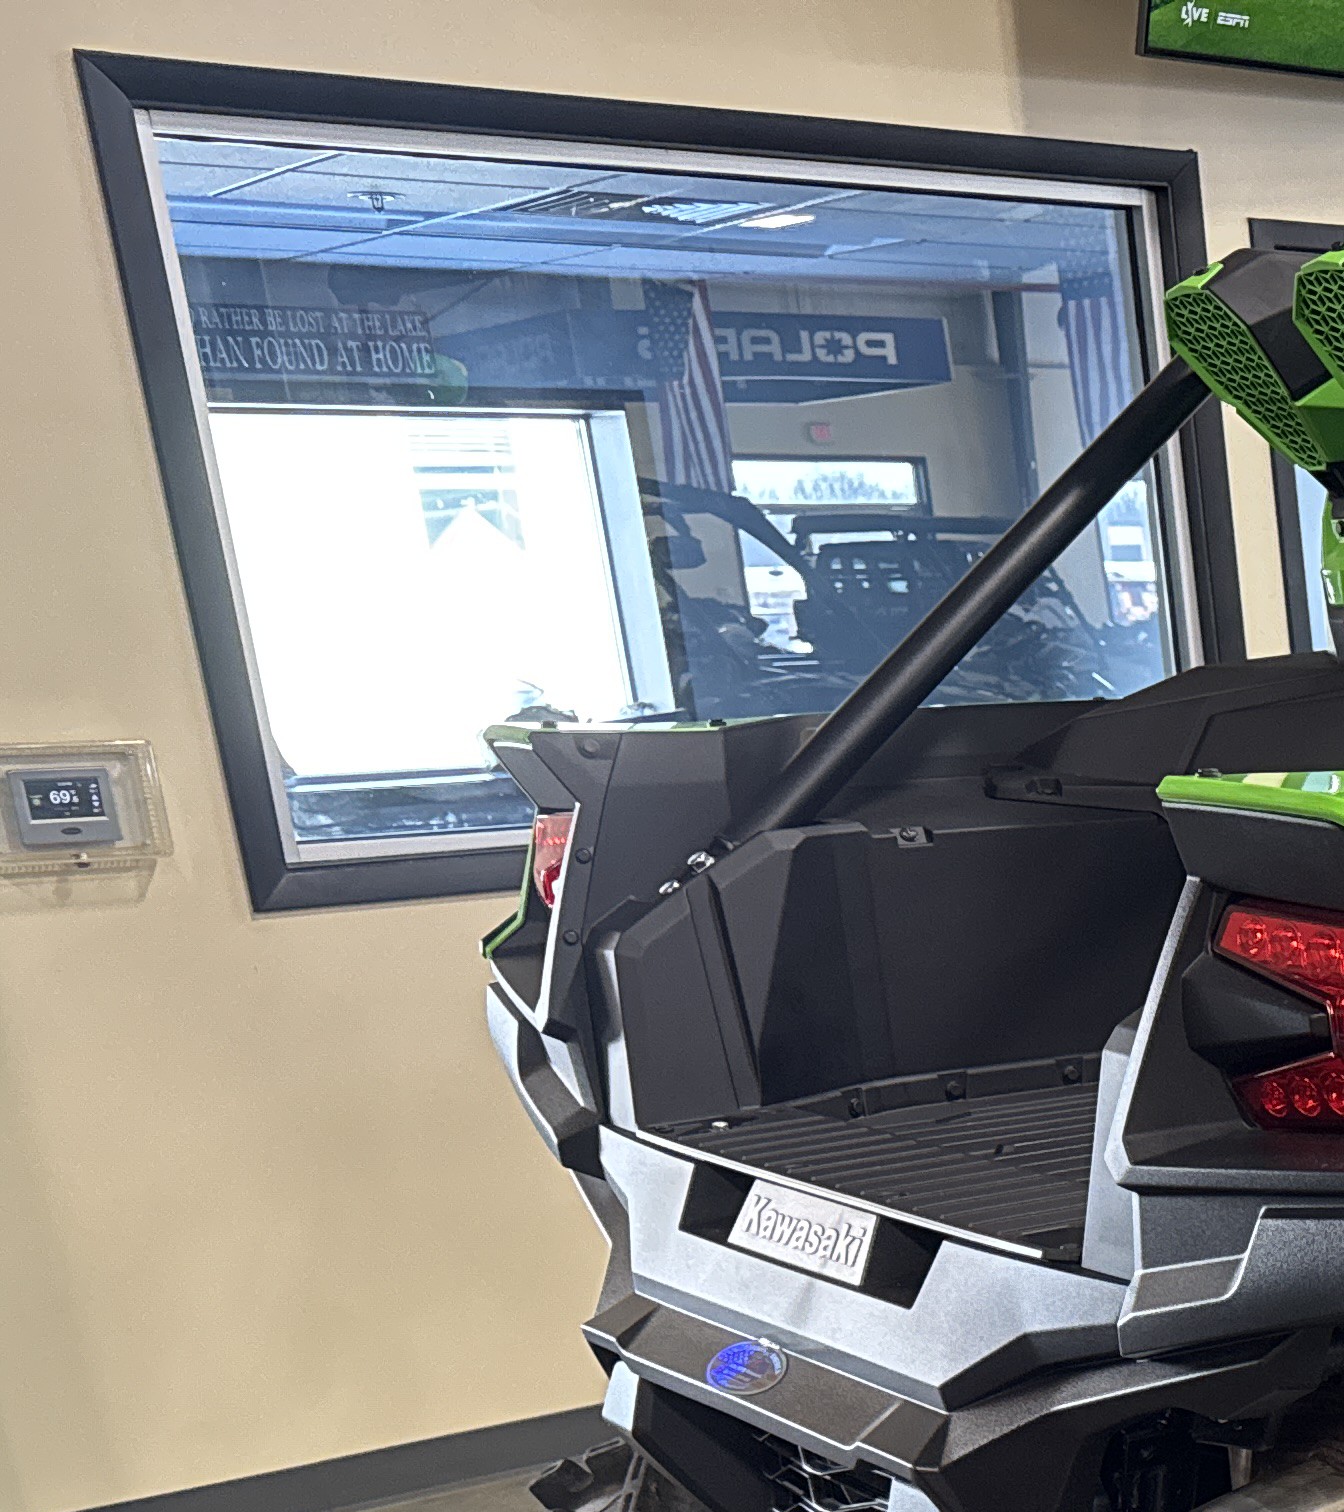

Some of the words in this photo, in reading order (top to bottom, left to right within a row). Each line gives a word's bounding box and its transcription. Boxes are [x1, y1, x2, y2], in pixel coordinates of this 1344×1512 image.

[1217, 12, 1250, 28] ESPN
[202, 307, 262, 330] RATHER
[267, 309, 285, 331] BE
[289, 311, 325, 333] LOST
[330, 312, 351, 334] AT
[353, 313, 383, 336] THE
[197, 335, 249, 369] HAN
[250, 337, 330, 371] FOUND
[335, 340, 363, 372] AT
[371, 341, 436, 375] HOME
[50, 789, 71, 804] 69
[742, 1193, 864, 1268] Kawasaki
